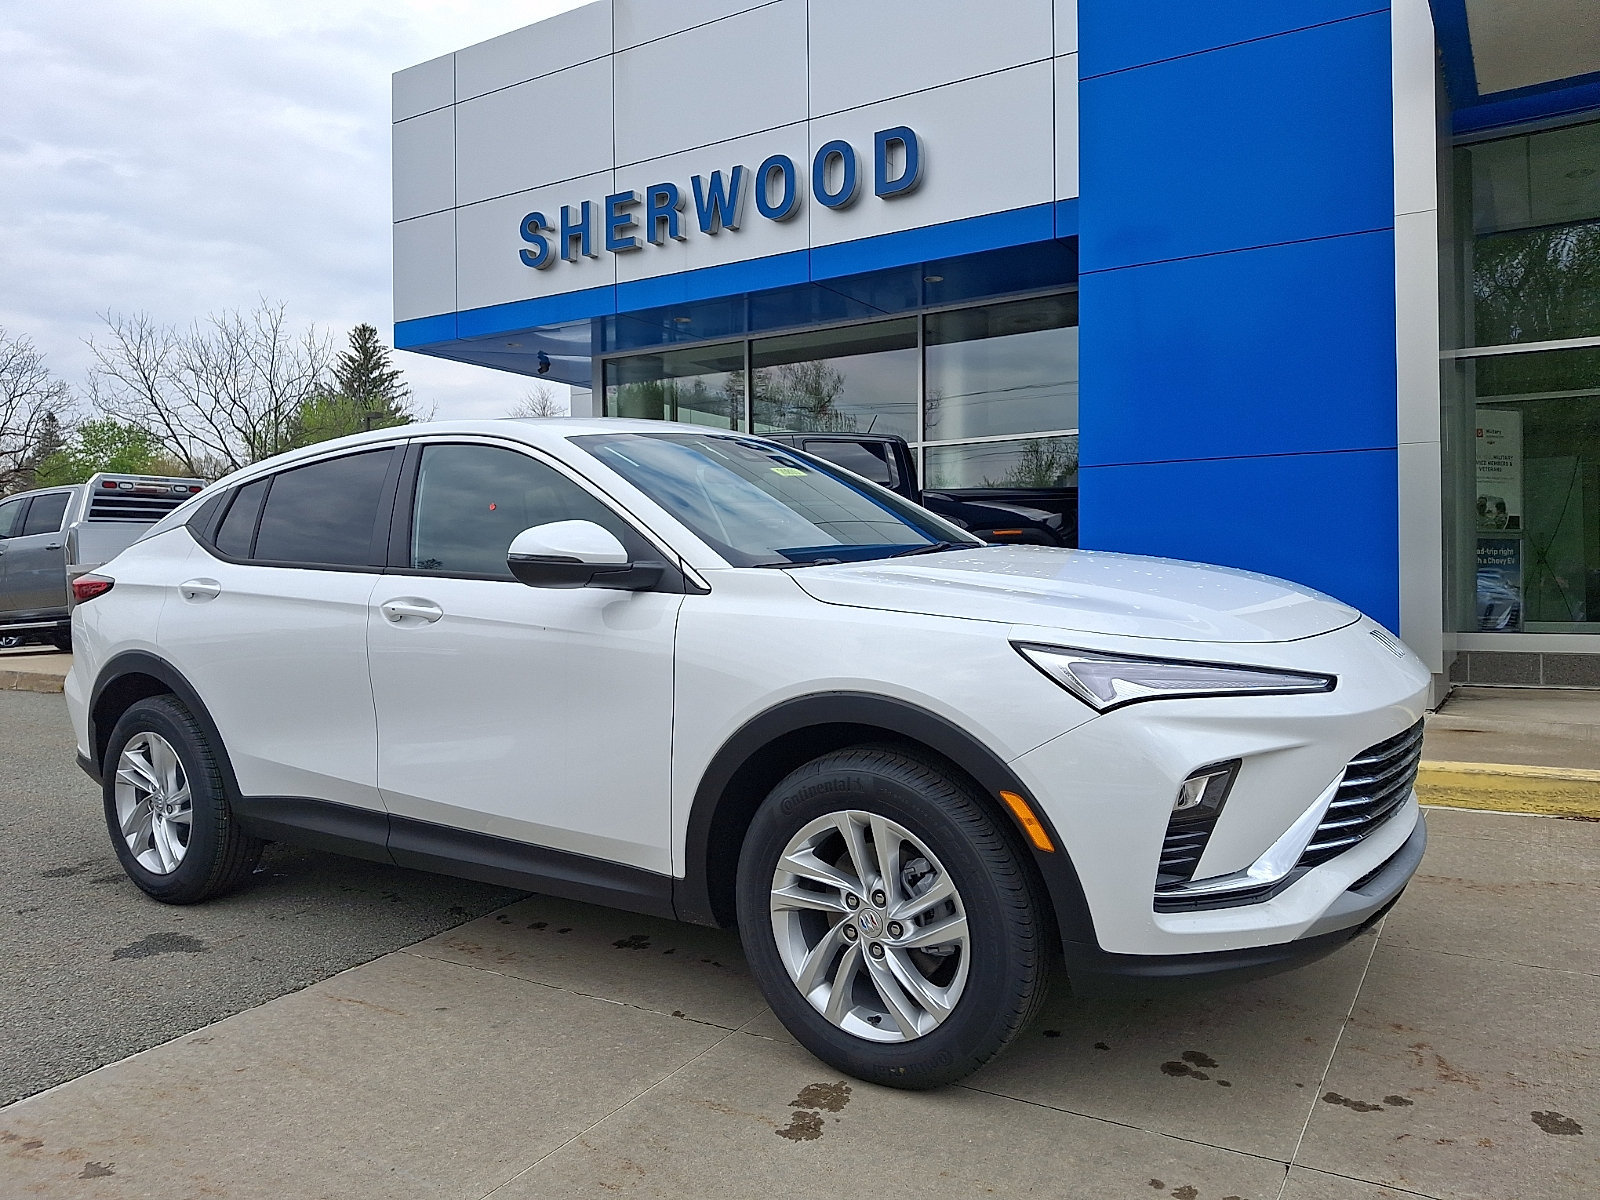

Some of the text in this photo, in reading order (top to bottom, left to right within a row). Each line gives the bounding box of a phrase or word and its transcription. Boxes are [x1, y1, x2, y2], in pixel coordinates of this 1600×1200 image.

[519, 125, 924, 270] SHERWOOD
[1476, 547, 1514, 556] ad-trip right
[782, 776, 851, 816] Continental
